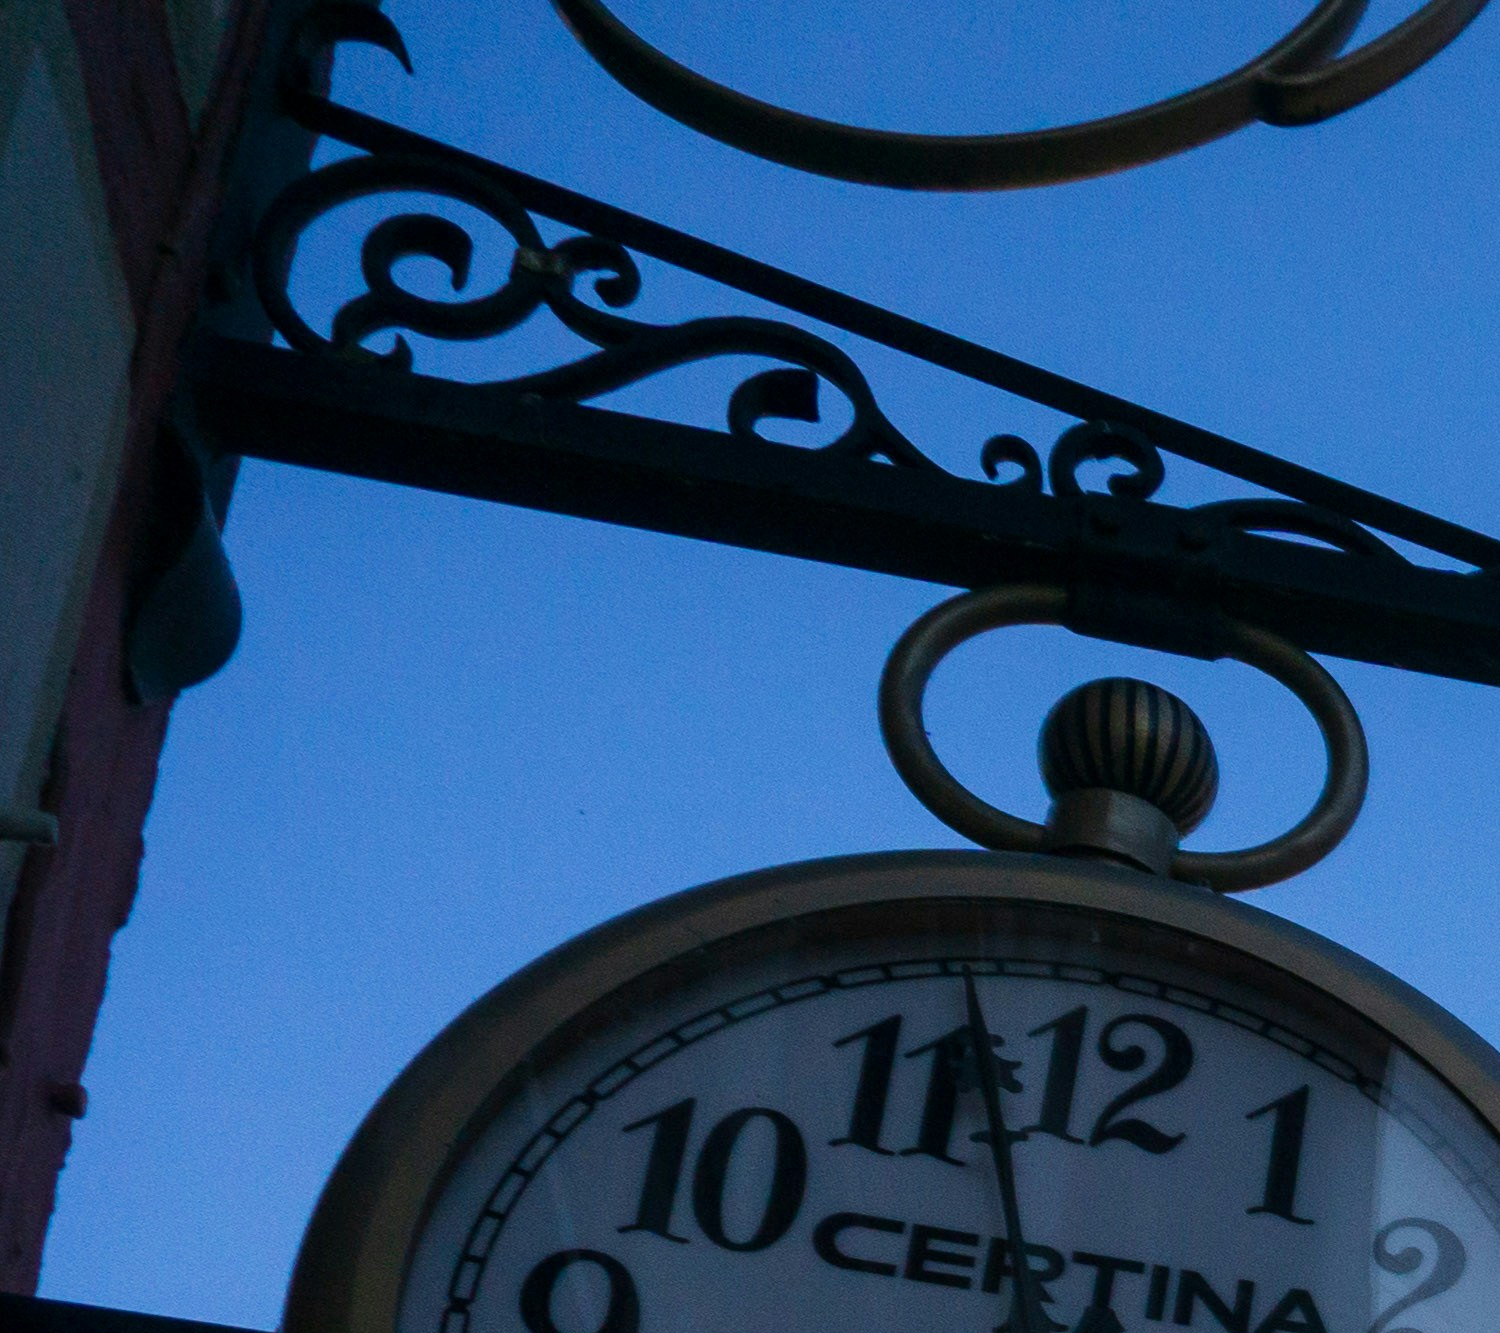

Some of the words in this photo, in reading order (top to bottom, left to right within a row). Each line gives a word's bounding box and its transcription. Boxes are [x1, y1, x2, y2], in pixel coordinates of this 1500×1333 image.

[828, 1012, 968, 1168] 11
[1024, 1003, 1195, 1155] 12
[1244, 1083, 1316, 1226] 1
[616, 1094, 808, 1254] 10
